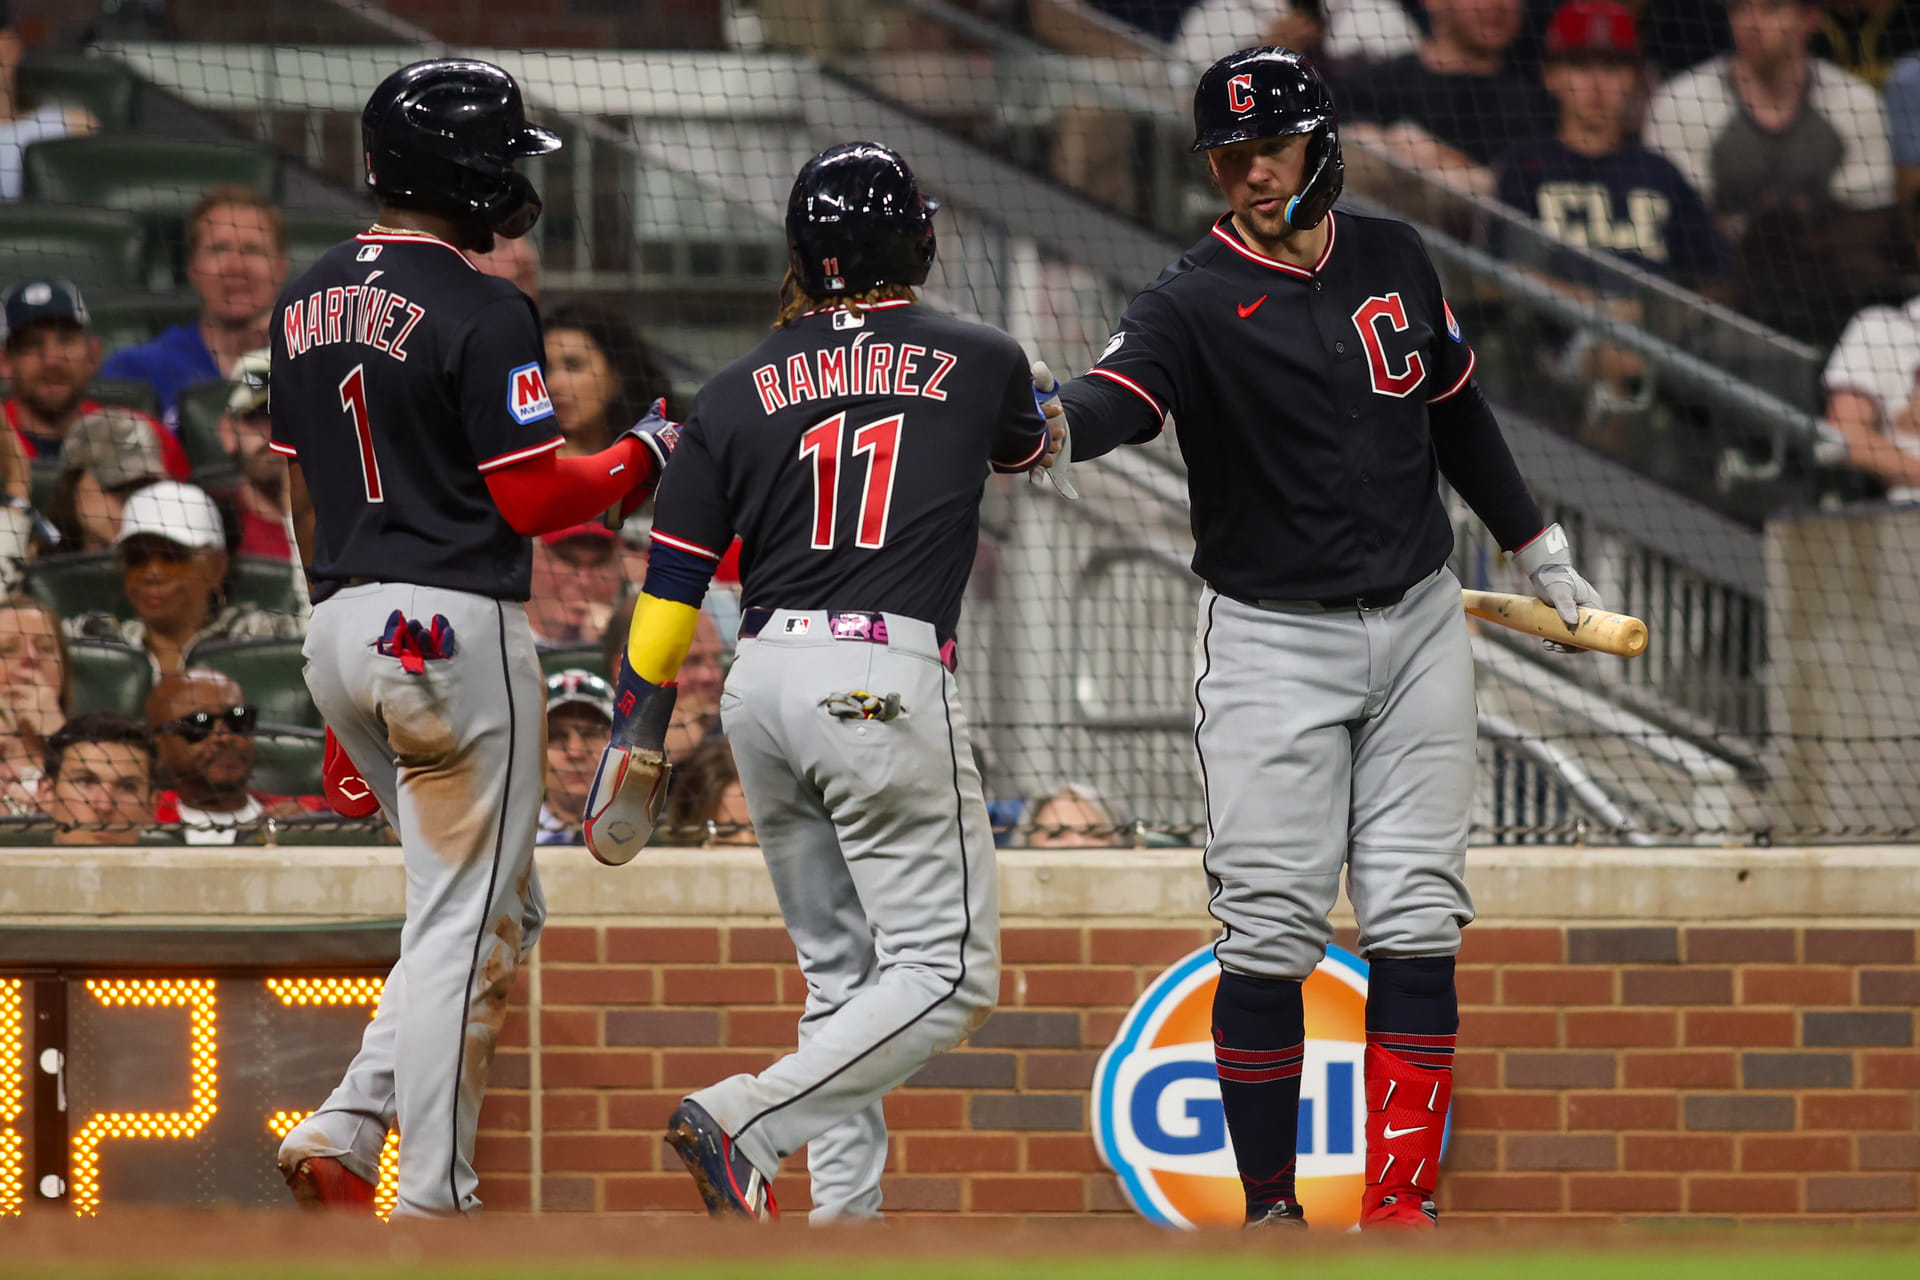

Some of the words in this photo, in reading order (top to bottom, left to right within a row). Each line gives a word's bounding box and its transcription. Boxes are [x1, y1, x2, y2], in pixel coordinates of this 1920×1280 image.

[1227, 74, 1255, 113] C
[822, 257, 839, 276] 11
[284, 270, 426, 362] MARTÍNEZ
[1351, 292, 1426, 398] C
[518, 370, 547, 406] M
[752, 332, 958, 416] RAMÍREZ
[338, 363, 384, 503] 1
[798, 411, 905, 550] 11
